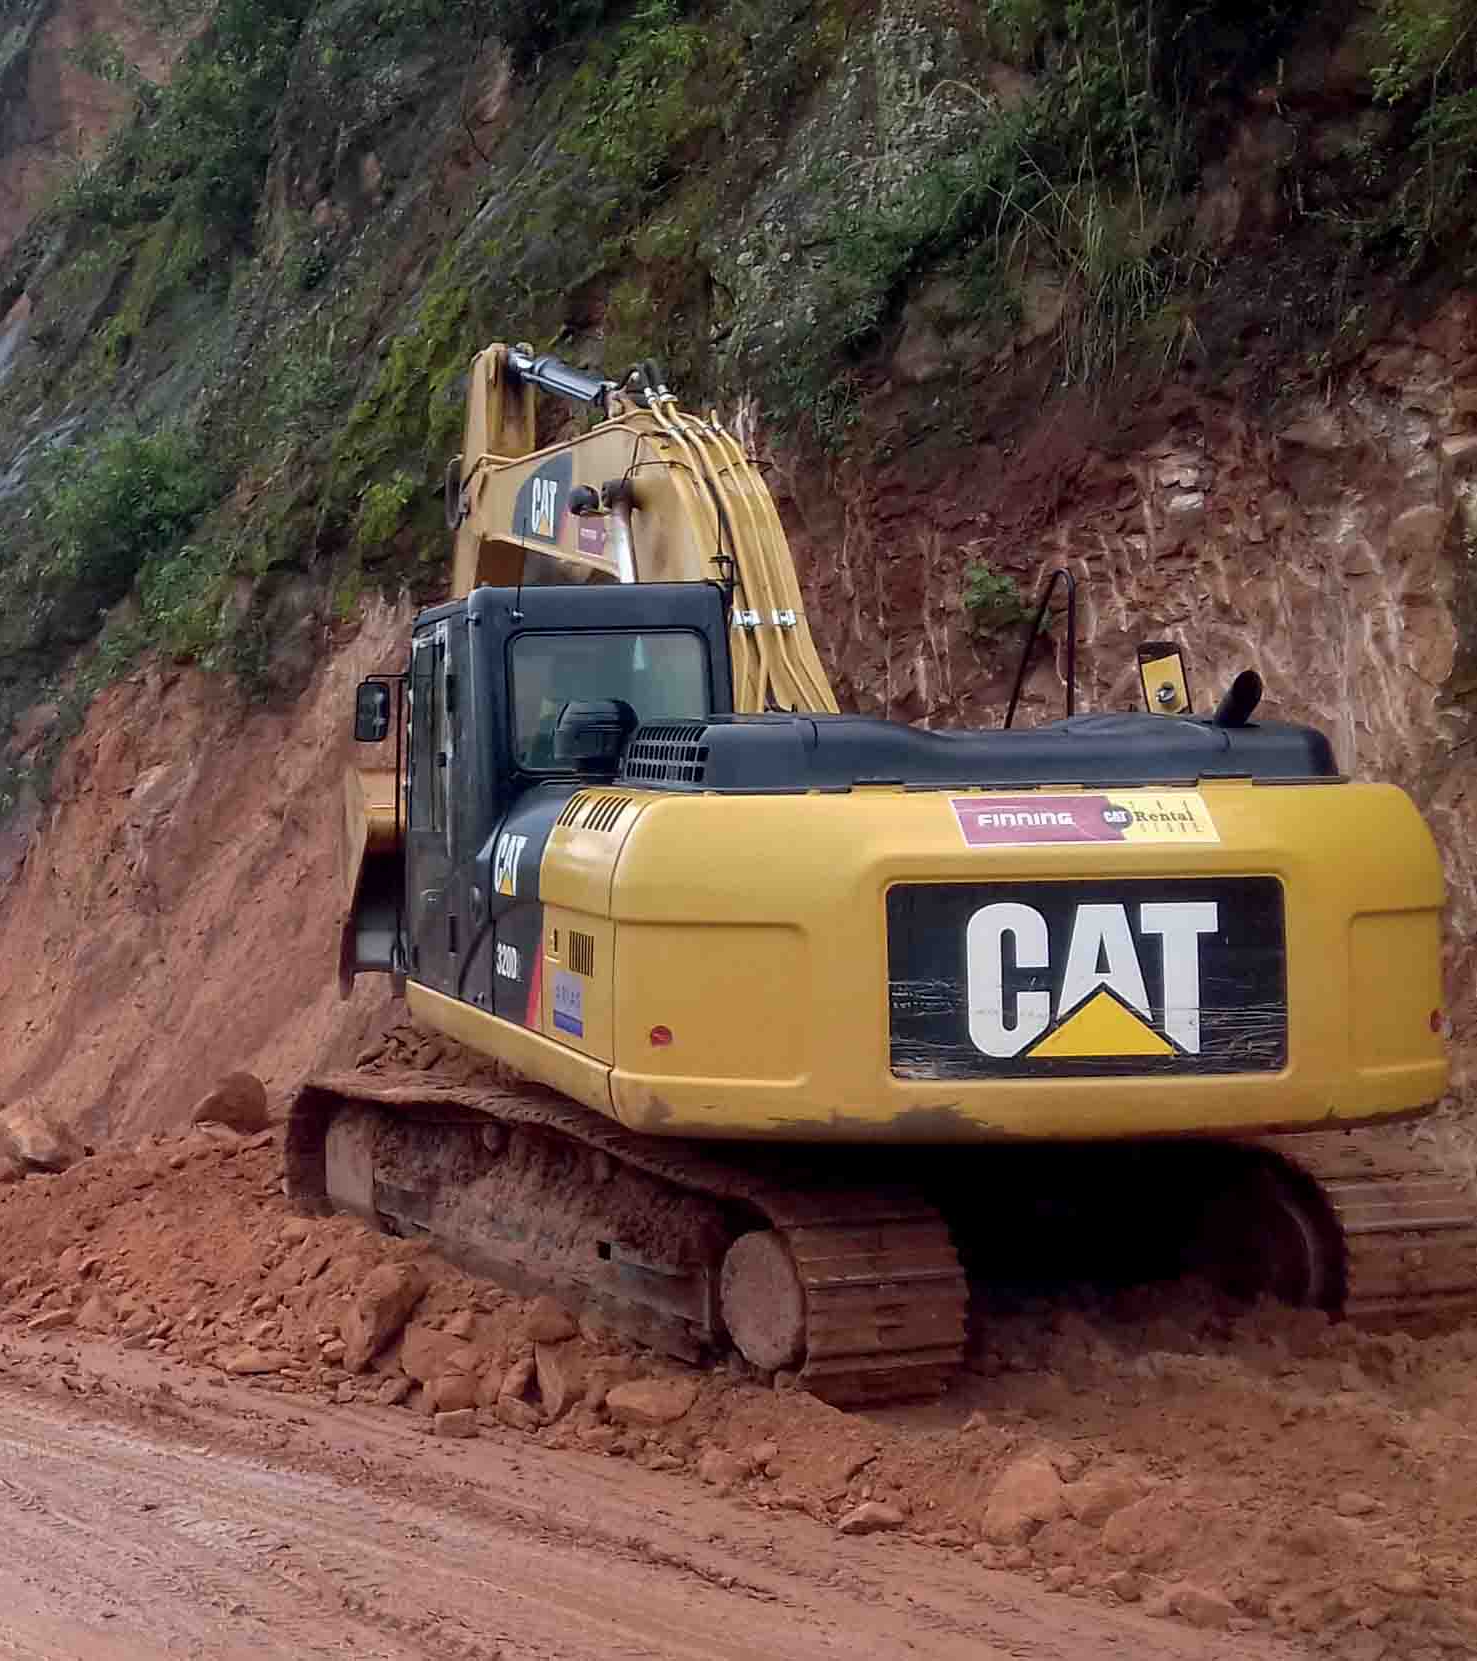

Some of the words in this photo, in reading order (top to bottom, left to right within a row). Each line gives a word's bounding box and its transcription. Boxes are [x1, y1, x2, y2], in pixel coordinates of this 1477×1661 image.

[531, 477, 557, 538] CAT
[977, 811, 1076, 827] FINNING
[1103, 810, 1128, 824] CAT
[1133, 809, 1195, 822] Rental
[494, 832, 528, 896] CAT
[966, 902, 1218, 1057] CAT
